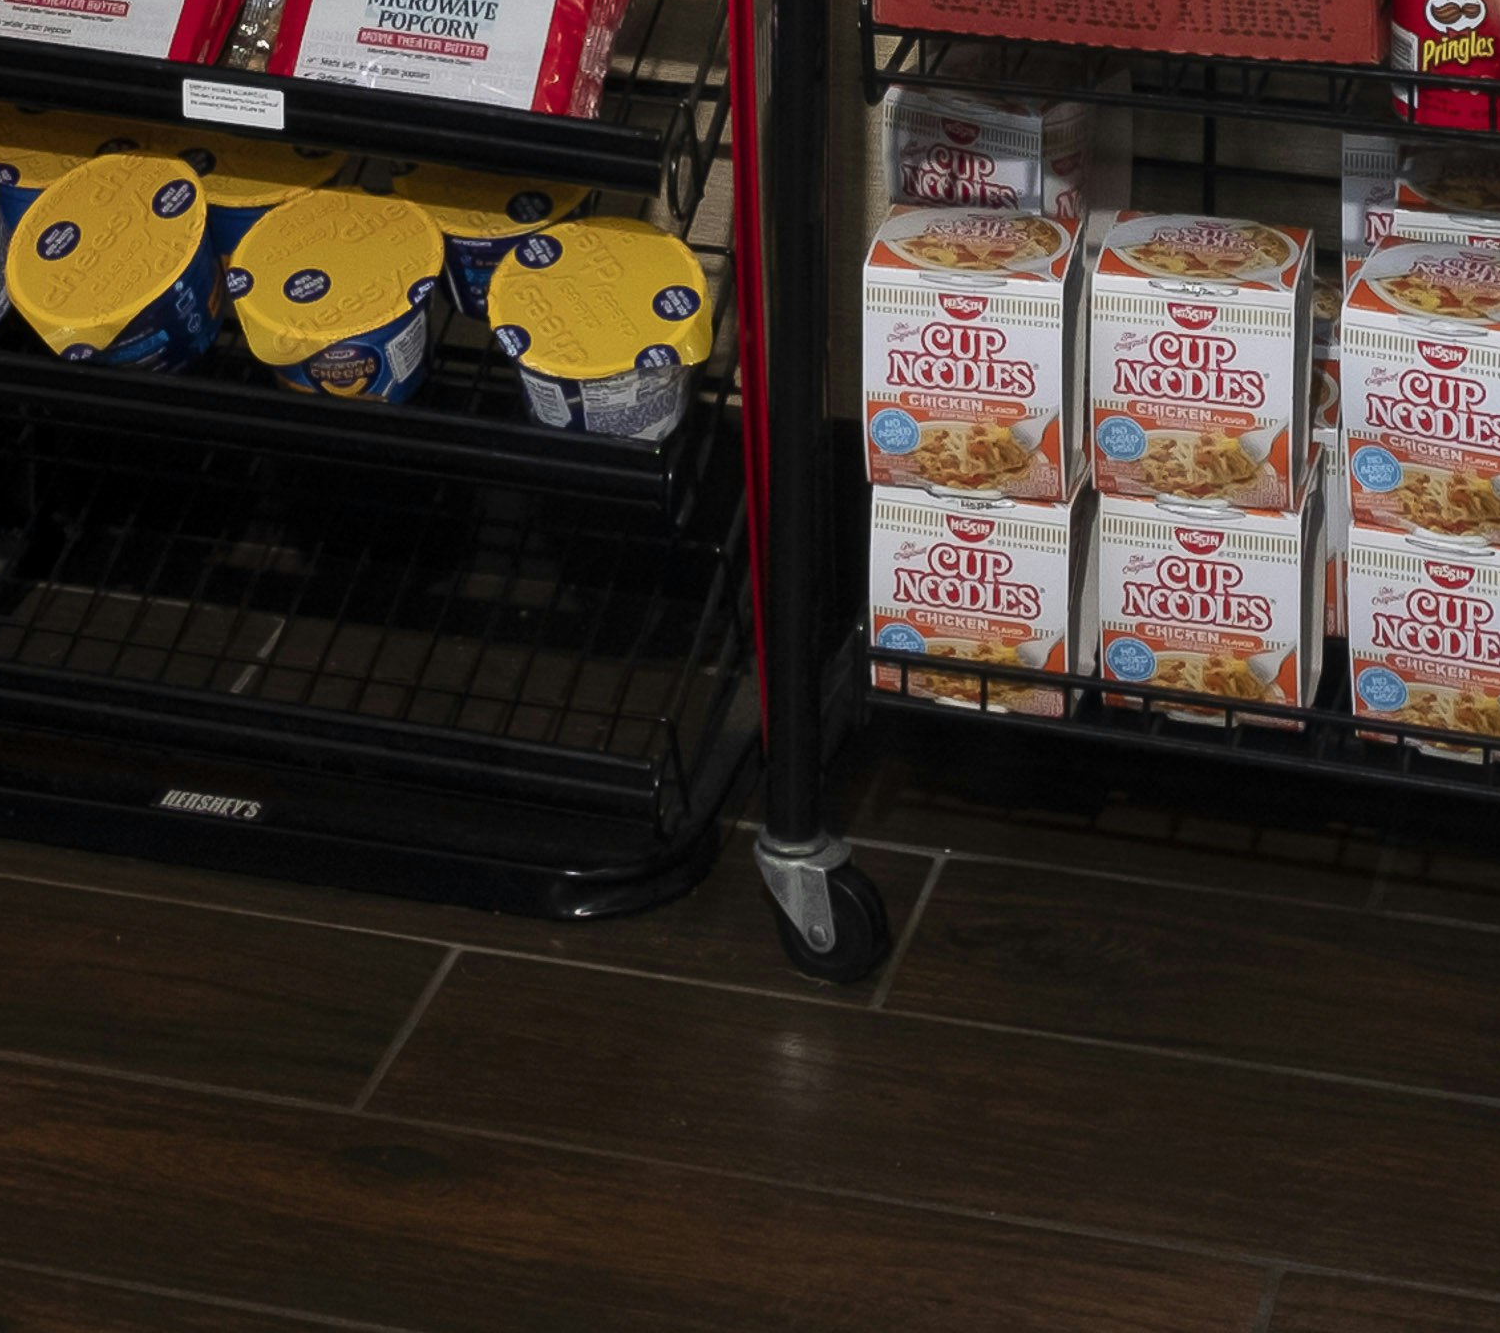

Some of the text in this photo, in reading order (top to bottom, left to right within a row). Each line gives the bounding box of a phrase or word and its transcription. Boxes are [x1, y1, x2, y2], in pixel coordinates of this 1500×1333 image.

[378, 9, 478, 39] POPCORN
[1422, 31, 1495, 74] Pringles
[927, 147, 995, 182] CUP
[921, 322, 1006, 359] CUP
[1150, 331, 1236, 368] CUP
[887, 349, 1036, 398] NOODLES
[1113, 359, 1265, 408] NOODLES
[1399, 370, 1486, 411] CUP
[908, 394, 983, 412] CHICKEN
[1136, 403, 1212, 420] CHICKEN
[1388, 435, 1462, 463] CHICKEN
[1179, 533, 1219, 547] NISSIN
[928, 543, 1013, 582] CUP
[893, 568, 1041, 620] NOODLES
[916, 611, 989, 630] CHICKEN
[161, 788, 262, 820] HERSHEY'S
